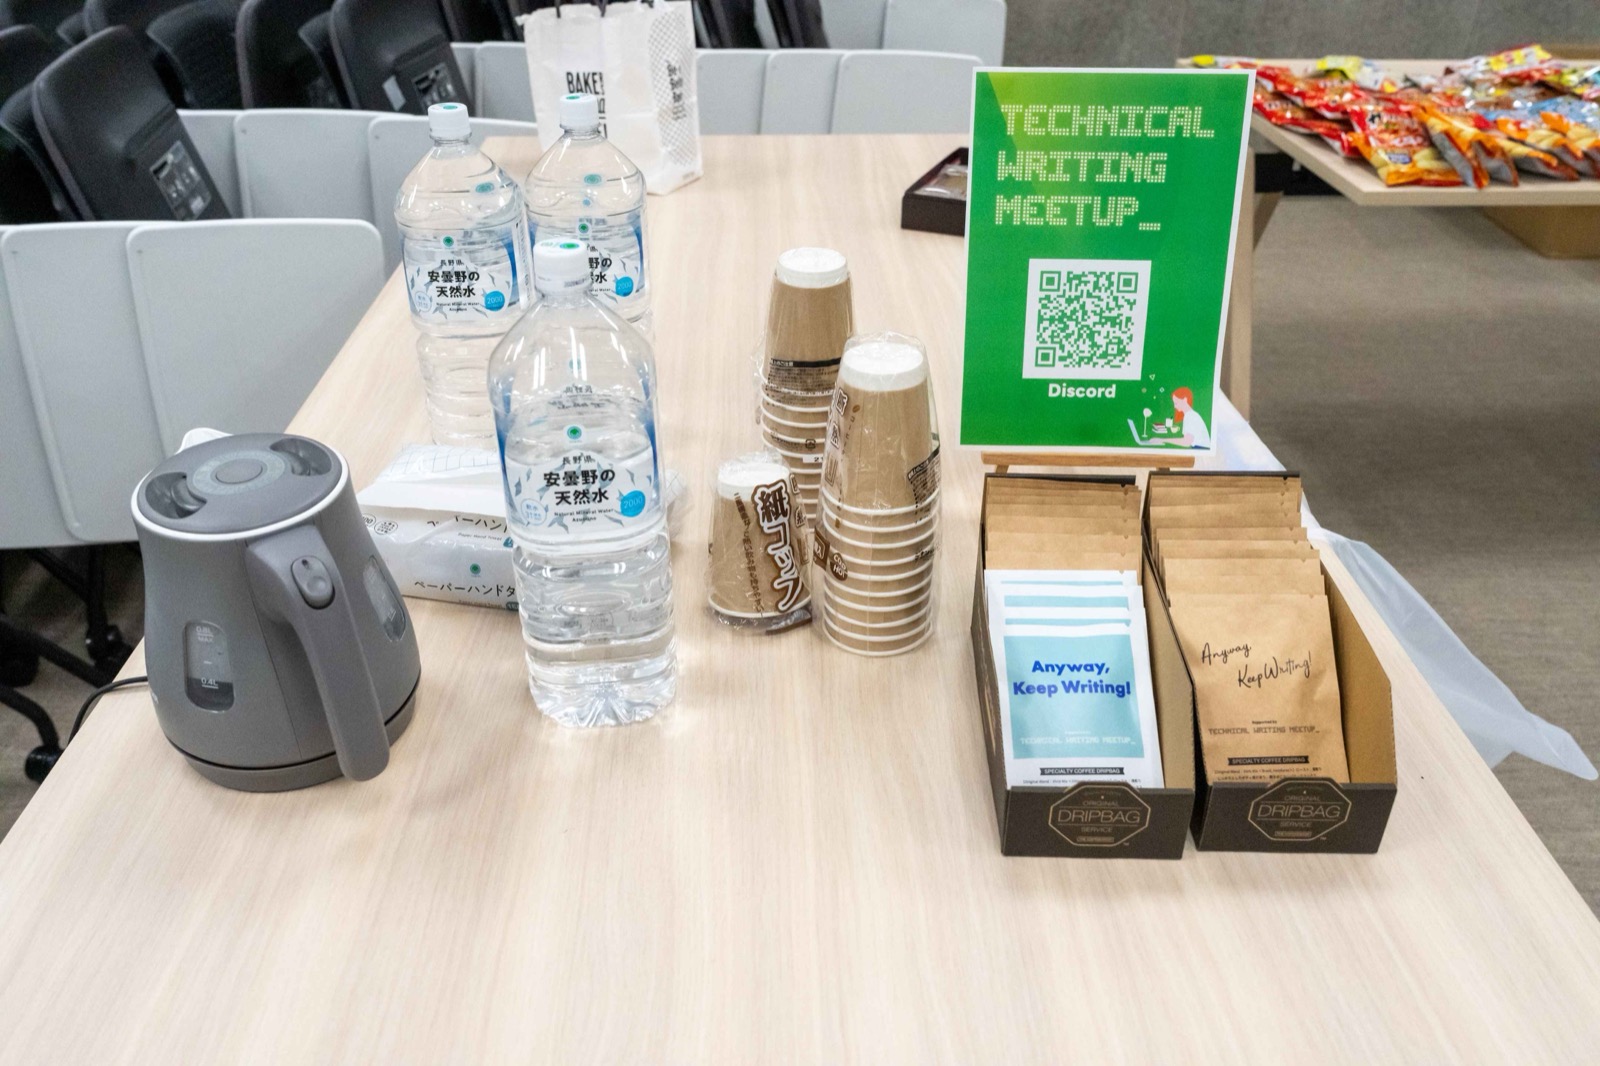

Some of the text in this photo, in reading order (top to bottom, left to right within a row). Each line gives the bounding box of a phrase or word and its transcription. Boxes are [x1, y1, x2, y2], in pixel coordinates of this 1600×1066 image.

[1001, 105, 1214, 137] TECHNICAL
[997, 151, 1167, 183] WRITING
[995, 195, 1161, 230] MEETUP_
[428, 270, 480, 283] 安曇野の
[436, 285, 476, 298] 天然水
[1048, 382, 1117, 398] Discord
[543, 469, 616, 488] 安曇野の
[554, 488, 609, 506] 天然水
[576, 508, 597, 516] Mineral
[833, 564, 848, 580] HOT
[1202, 643, 1251, 666] Anyway,
[1032, 660, 1110, 676] Anyway,
[201, 677, 217, 686] 0.4L
[1013, 679, 1131, 698] Keep Writing!
[1057, 809, 1141, 823] DRIPBAG
[1257, 804, 1341, 818] DRIPBAG
